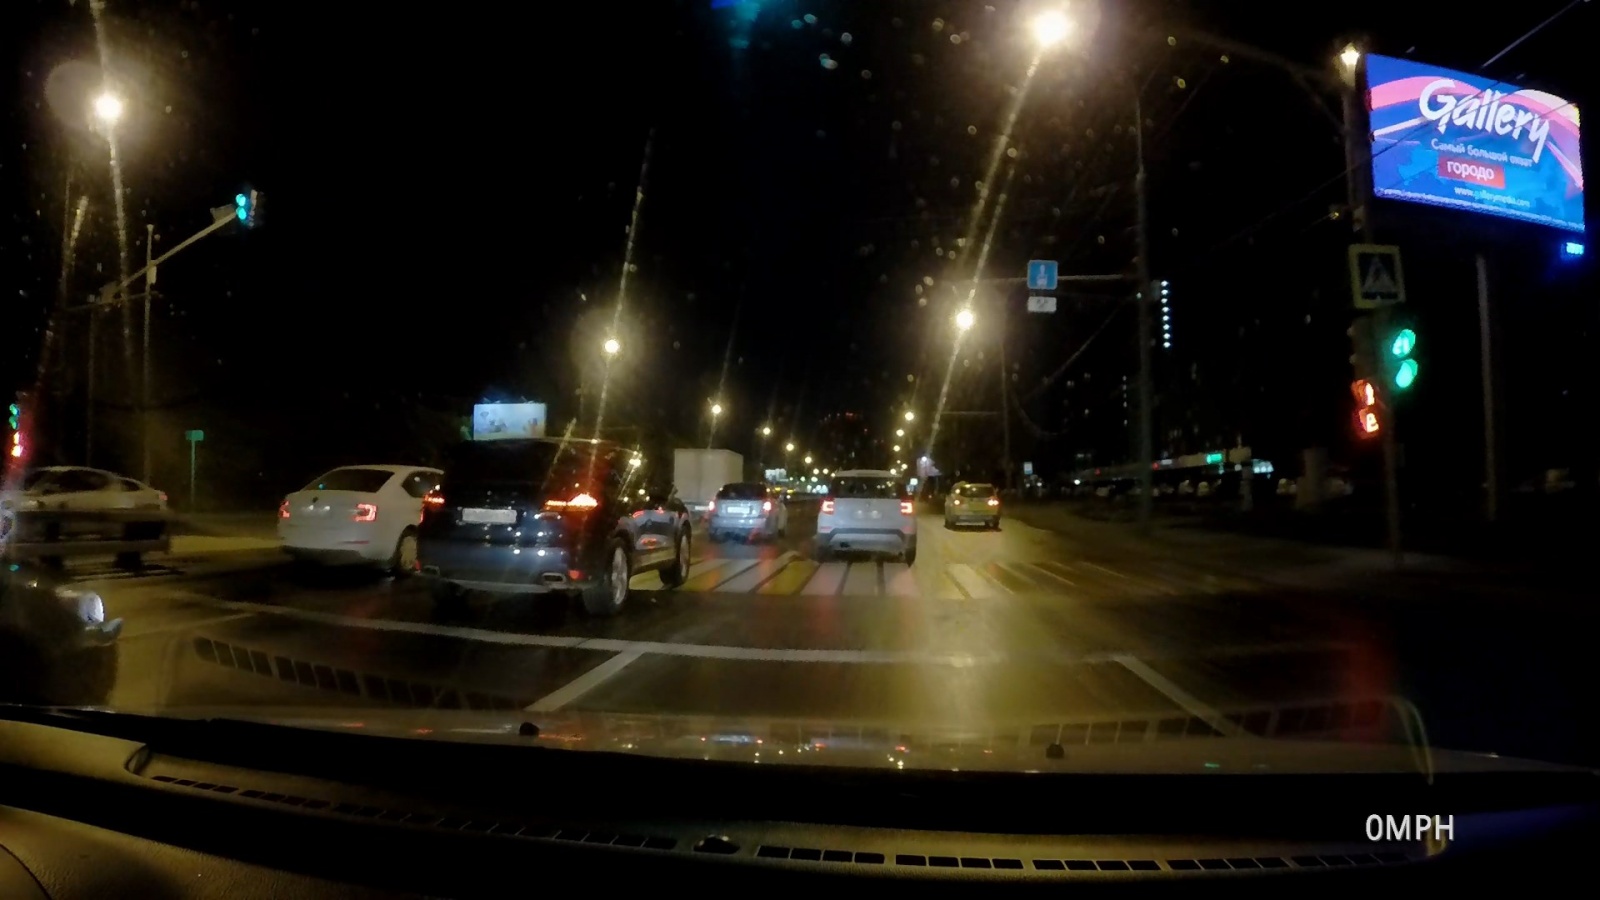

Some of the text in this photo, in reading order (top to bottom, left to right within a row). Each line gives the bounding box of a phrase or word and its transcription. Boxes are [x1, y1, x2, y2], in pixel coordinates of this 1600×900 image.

[1419, 77, 1549, 163] Gallery
[1431, 138, 1465, 153] Самый
[1467, 144, 1508, 162] большой
[1447, 161, 1494, 181] городо
